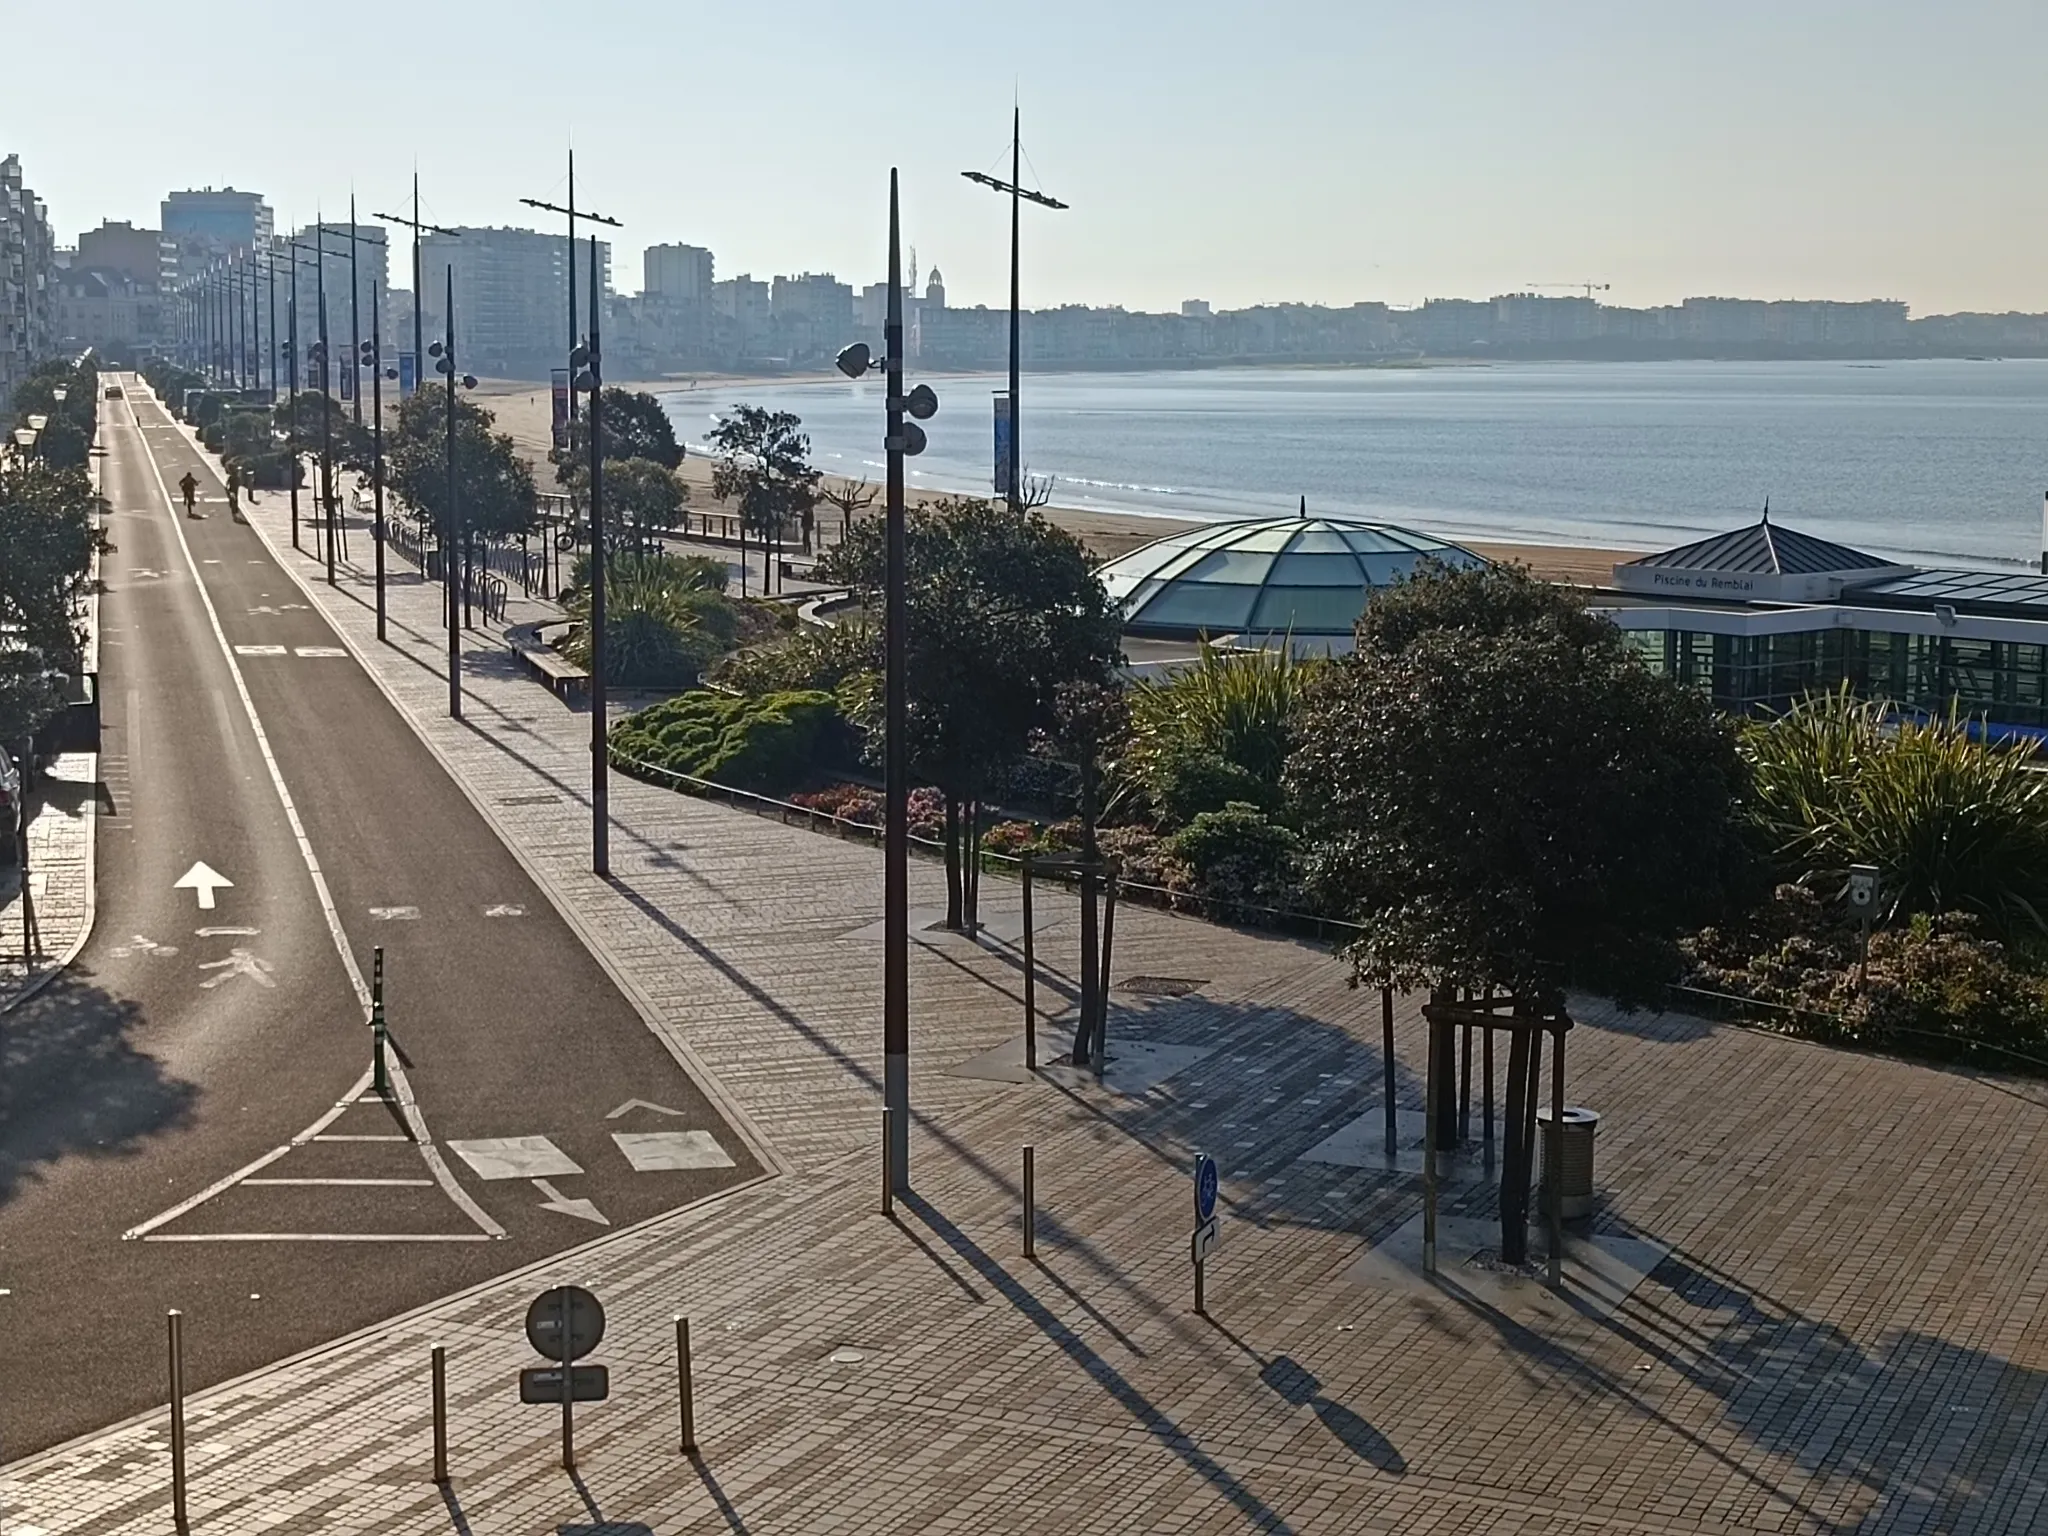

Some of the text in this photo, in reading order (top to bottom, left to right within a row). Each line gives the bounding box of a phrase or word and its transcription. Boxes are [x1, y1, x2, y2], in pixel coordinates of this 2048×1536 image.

[1654, 574, 1754, 591] Piscine du Remblai
